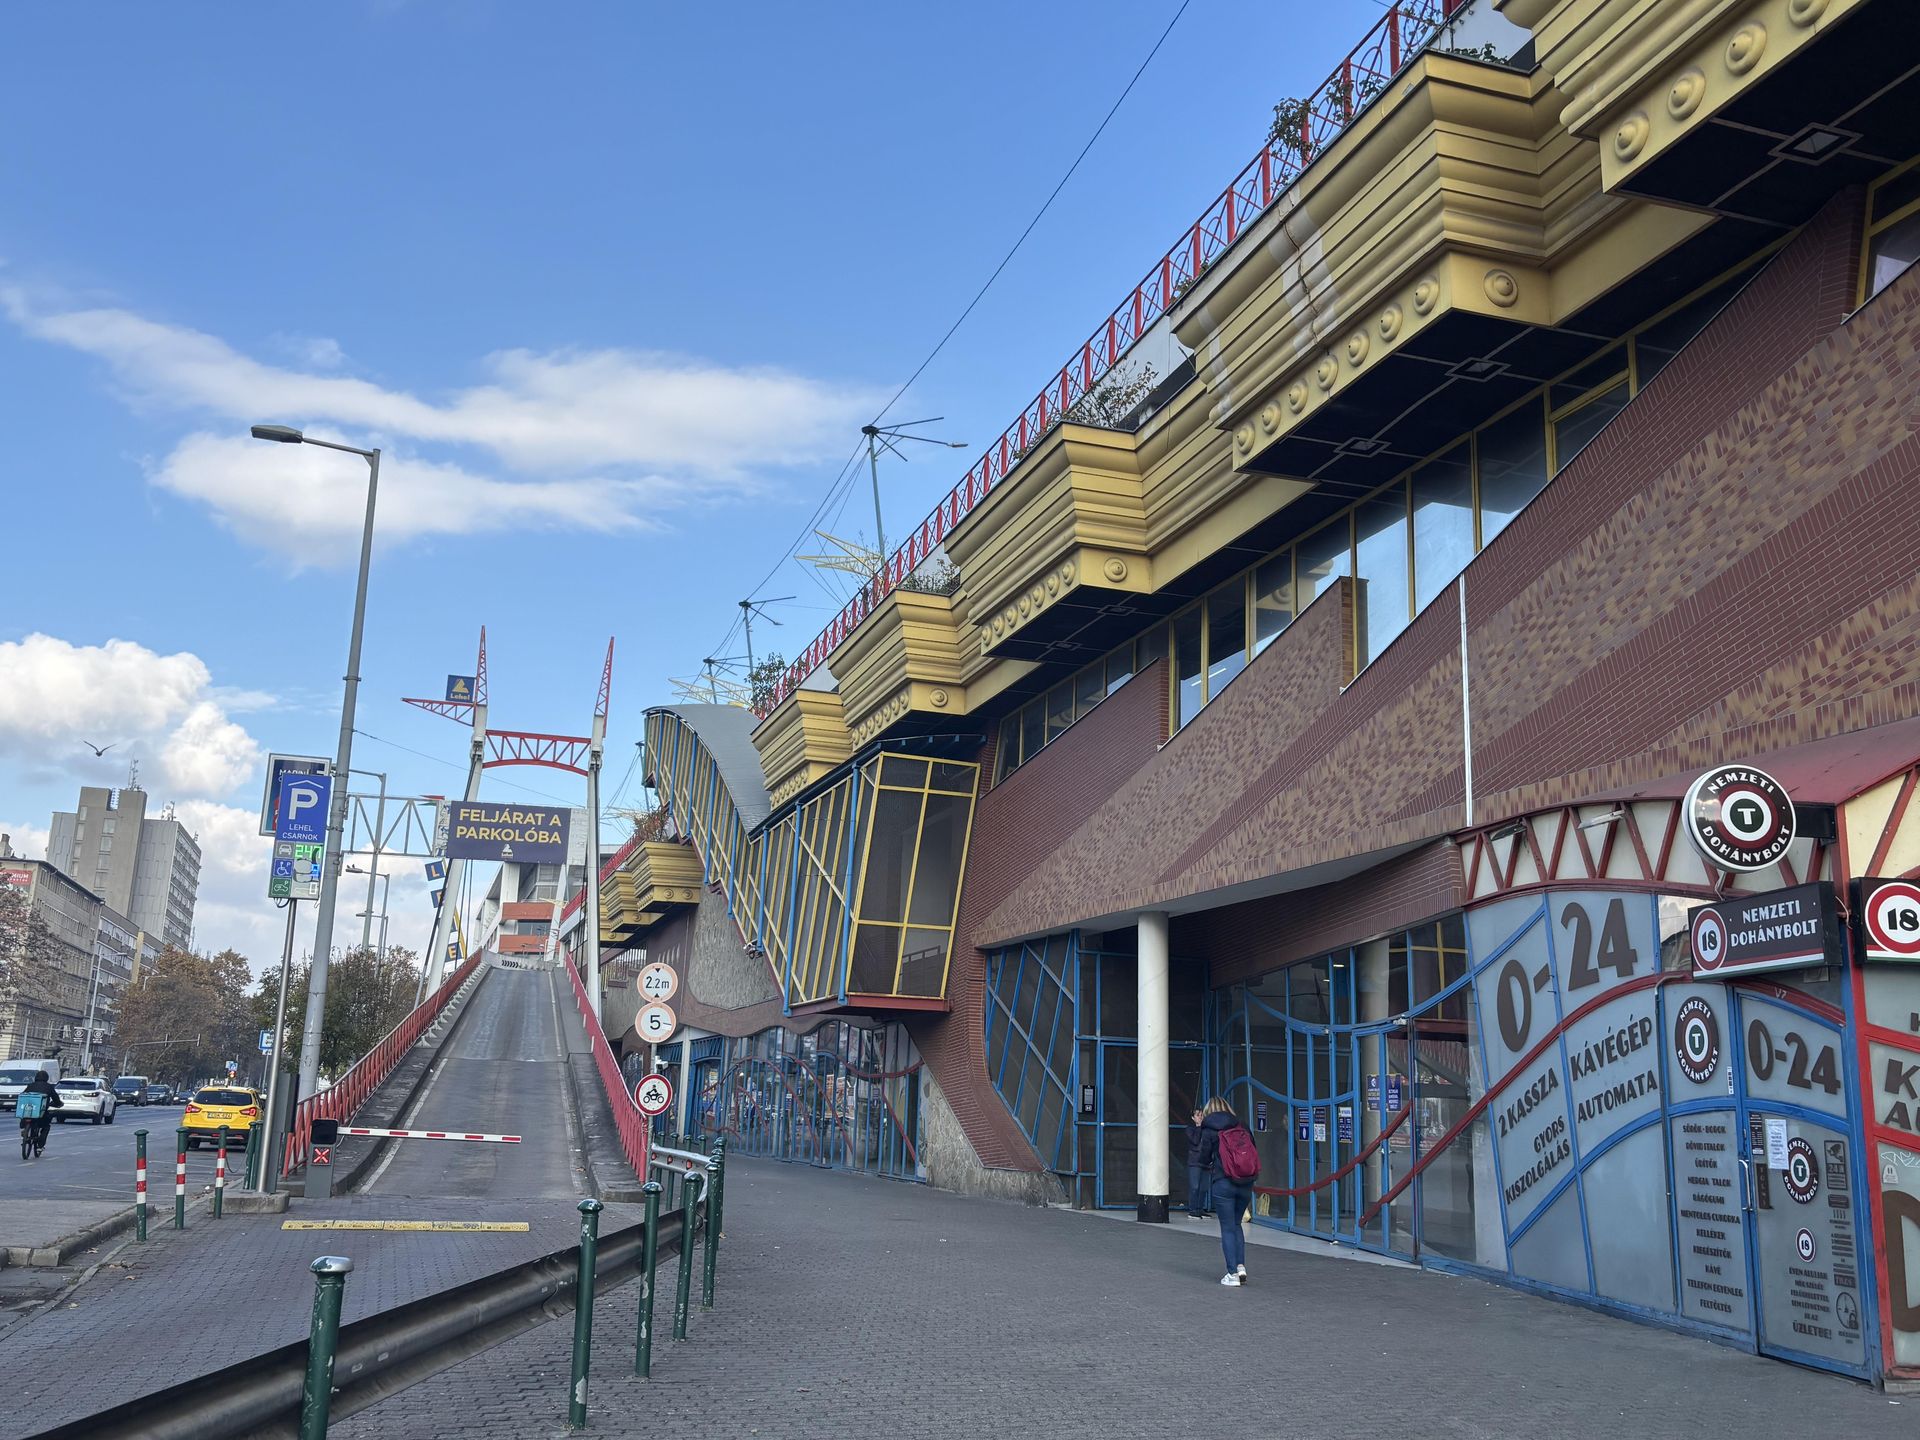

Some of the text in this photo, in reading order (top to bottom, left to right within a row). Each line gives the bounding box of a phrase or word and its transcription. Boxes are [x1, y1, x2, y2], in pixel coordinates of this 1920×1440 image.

[1707, 772, 1775, 794] NEMZETI
[288, 788, 319, 820] P
[289, 823, 313, 832] LEHEL
[459, 807, 562, 827] FELJÁRAT A
[1737, 808, 1756, 825] T
[282, 832, 318, 841] CSARNOK
[456, 825, 562, 844] PARKOLÓBA
[1702, 825, 1790, 863] DOHÁNYBOLT
[1742, 899, 1801, 924] NEMZETI
[1887, 908, 1919, 932] 18
[1701, 930, 1718, 951] 18
[1730, 919, 1818, 947] DOHÁNYBOLT
[1497, 898, 1638, 1052] 0-24
[649, 1014, 661, 1030] 5
[1680, 1000, 1712, 1022] NEMZETI
[1570, 1014, 1653, 1081] KÁVÉGÉP
[1691, 1033, 1701, 1049] T
[1677, 1047, 1719, 1081] DOHÁNYBOLT
[1748, 1019, 1842, 1095] 0-24
[1498, 1067, 1559, 1138] 2 KASSZA
[1577, 1070, 1658, 1124] AUTOMATA
[1884, 1101, 1920, 1131] A
[1533, 1115, 1565, 1154] GYORS
[1505, 1138, 1570, 1206] KISZOLGÁLÁS
[1796, 1165, 1804, 1177] T
[1784, 1177, 1819, 1203] DOHÁNYBOLT
[1801, 1240, 1810, 1251] 18
[1686, 1278, 1712, 1290] TELEFON
[1700, 1298, 1732, 1313] FELTÖLTÉS
